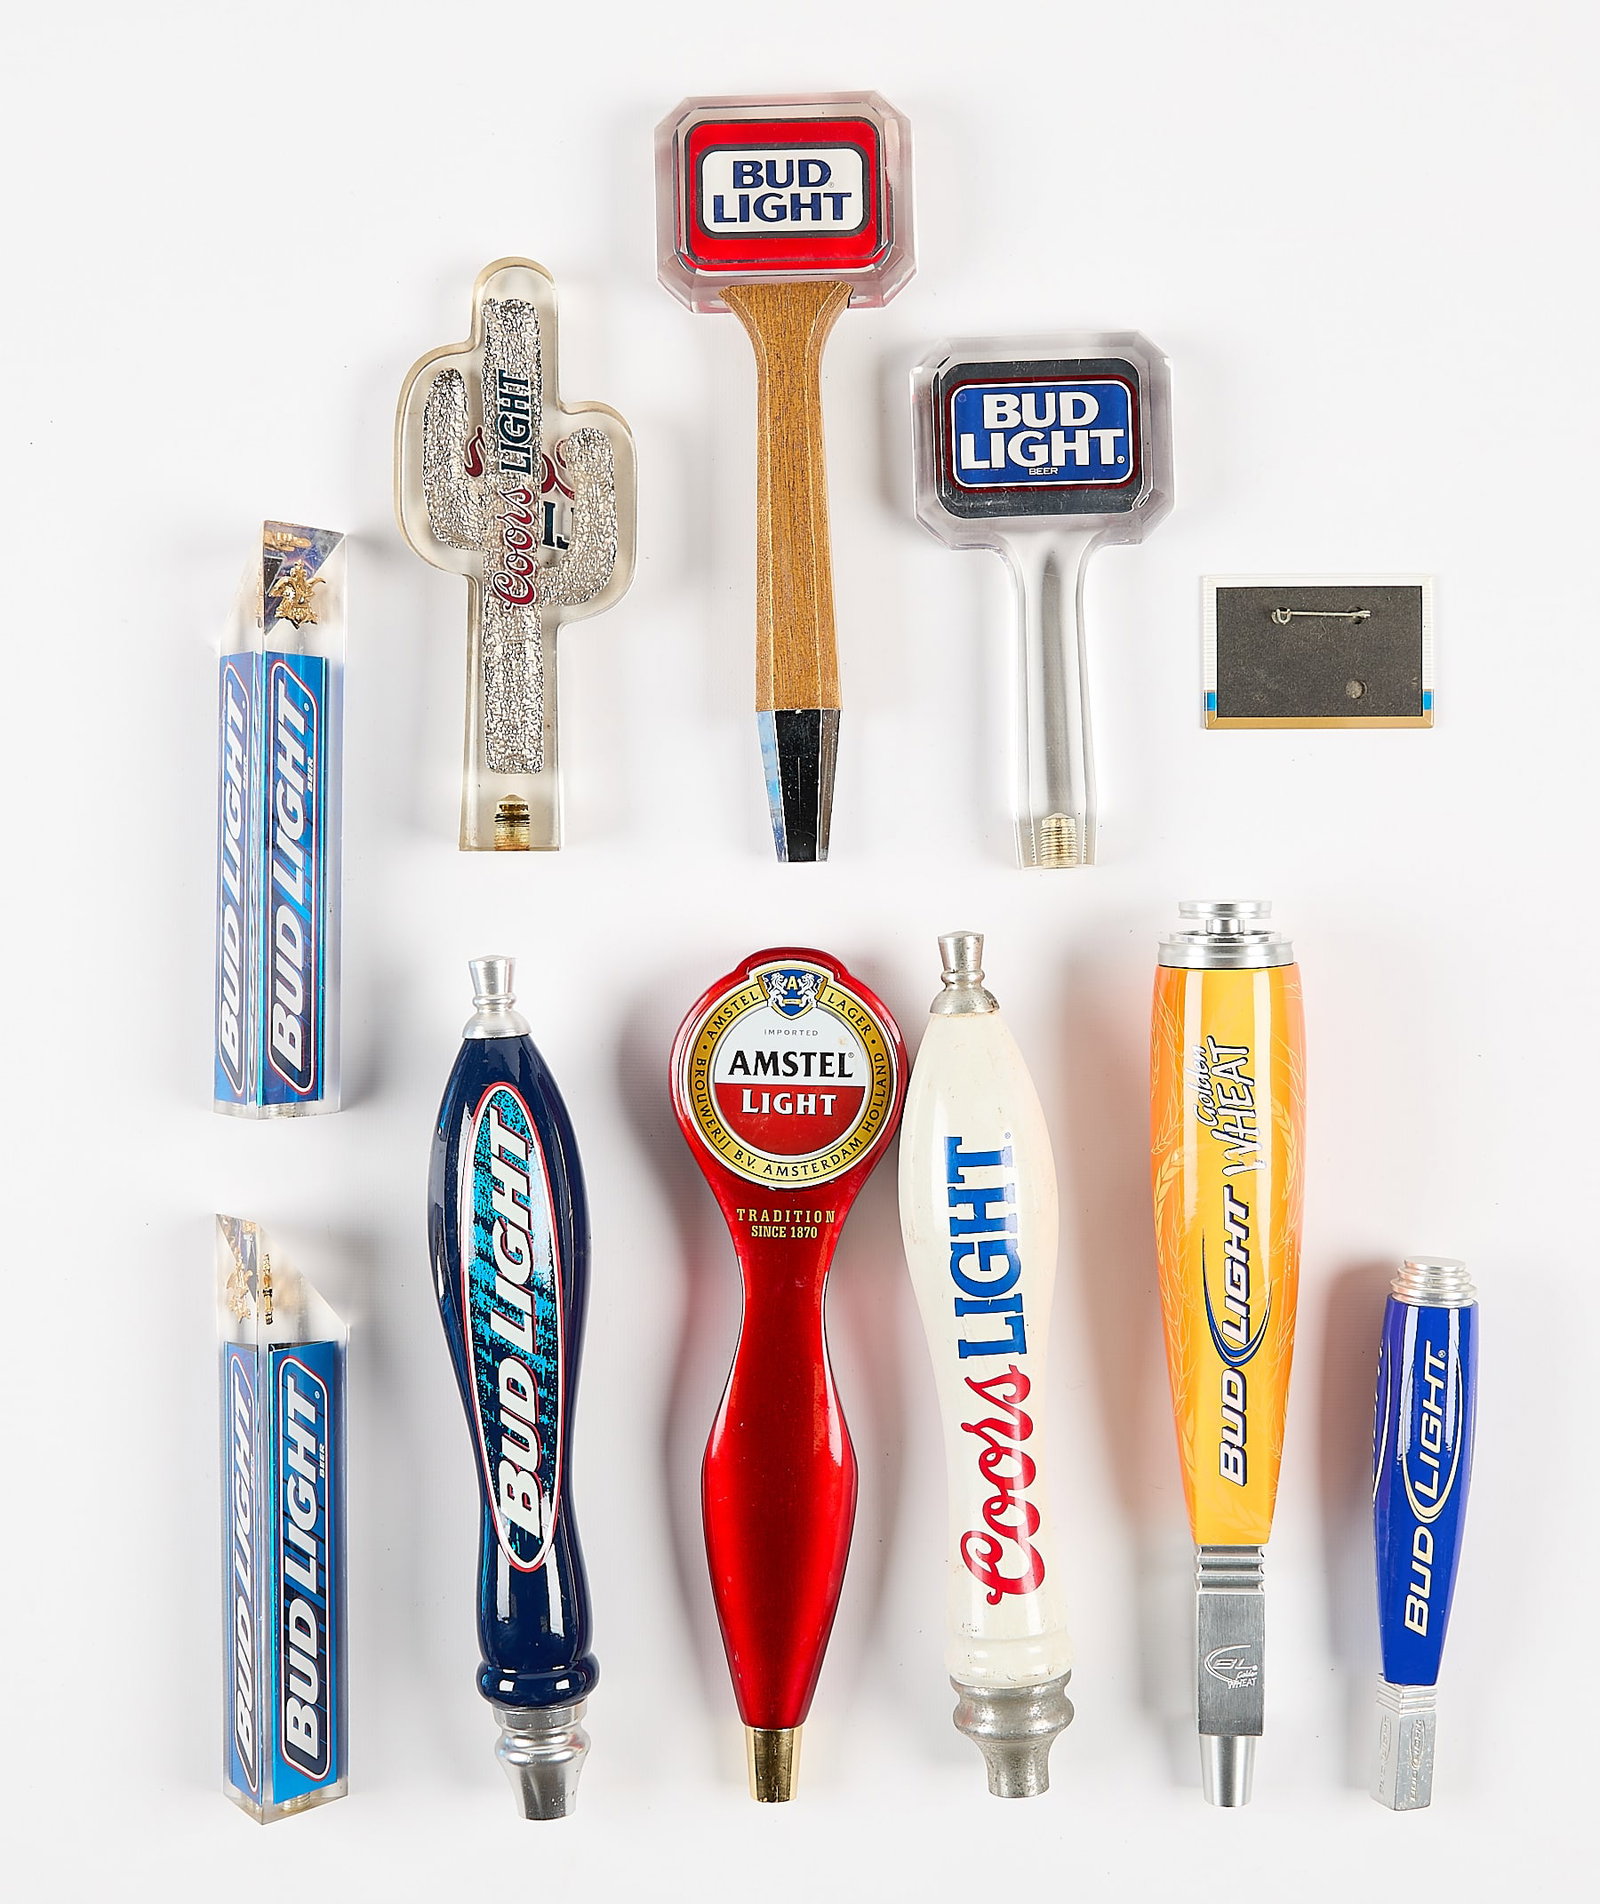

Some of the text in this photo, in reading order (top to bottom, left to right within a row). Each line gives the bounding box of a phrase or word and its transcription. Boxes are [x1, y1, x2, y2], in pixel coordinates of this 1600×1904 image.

[733, 159, 832, 189] BUD
[713, 192, 852, 223] LIGHT
[983, 391, 1099, 429] BUD
[960, 428, 1124, 469] LIGHT
[1028, 467, 1058, 476] BEER
[492, 368, 537, 611] Coors LIGHT
[221, 680, 244, 1073] BUD LIGHT
[272, 678, 306, 1072] BUD LIGHT
[785, 975, 798, 989] A
[706, 991, 873, 1041] AMSTEL LAGER
[764, 1028, 819, 1037] IMPORTED
[728, 1050, 854, 1078] AMSTEL
[1185, 1044, 1219, 1127] Golden
[694, 1052, 887, 1177] BROUWERIJ B.V. AMSTERDAM HOLLAND
[742, 1088, 838, 1117] LIGHT
[1207, 1035, 1267, 1177] WHEAT
[736, 1208, 836, 1223] TRADITION
[751, 1225, 818, 1239] SINCE 1870
[490, 1105, 543, 1539] BUD LIGHT
[1219, 1184, 1251, 1488] BUD LIGHT
[943, 1135, 1045, 1606] Coors LIGHT
[1404, 1340, 1449, 1637] BUD LIGHT
[234, 1371, 253, 1769] BUD LIGHT
[284, 1374, 319, 1759] BUD LIGHT
[1227, 1676, 1258, 1690] WHEAT
